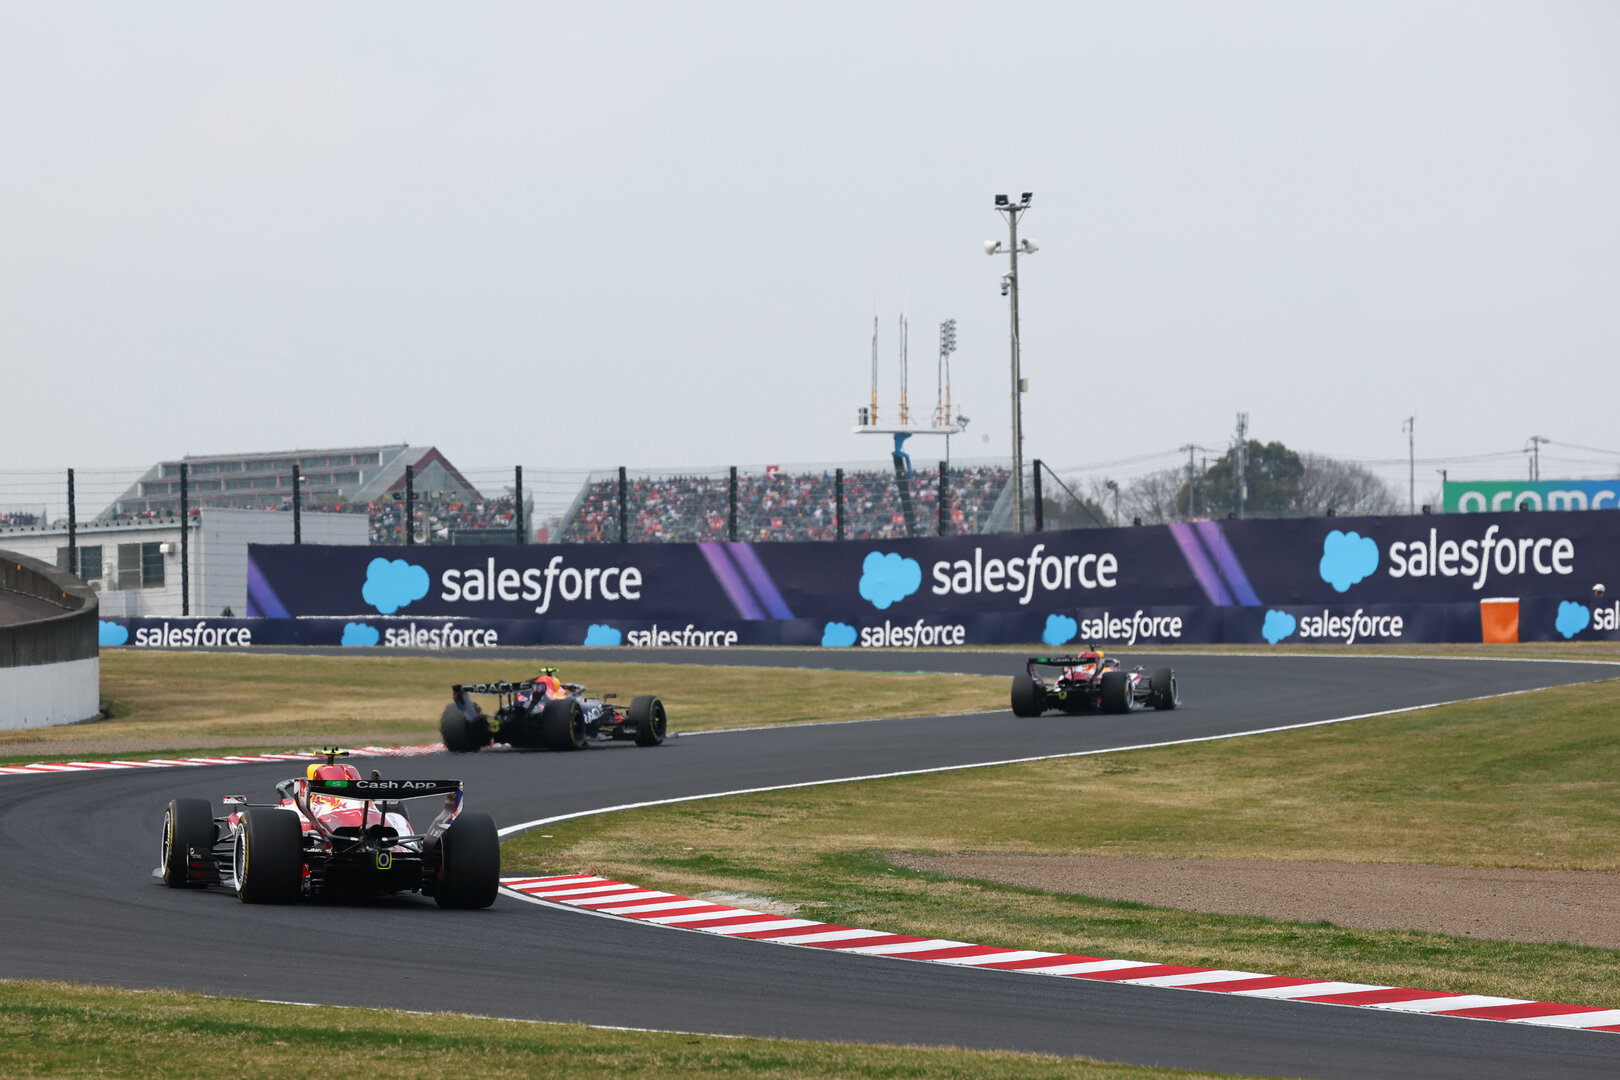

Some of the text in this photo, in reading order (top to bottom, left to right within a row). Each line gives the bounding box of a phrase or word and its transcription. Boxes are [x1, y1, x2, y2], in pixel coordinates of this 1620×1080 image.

[1458, 490, 1620, 513] aramc
[1388, 524, 1575, 590] salesforce
[441, 555, 643, 615] salesforce
[932, 543, 1118, 605] salesforce
[1080, 609, 1183, 647] salesforce
[1299, 608, 1404, 646] salesforce
[1593, 600, 1620, 630] sal
[134, 621, 252, 648] salesforce
[384, 622, 498, 649] salesforce
[627, 623, 738, 648] salesforce
[860, 618, 966, 648] salesforce
[356, 780, 437, 790] Cash App
